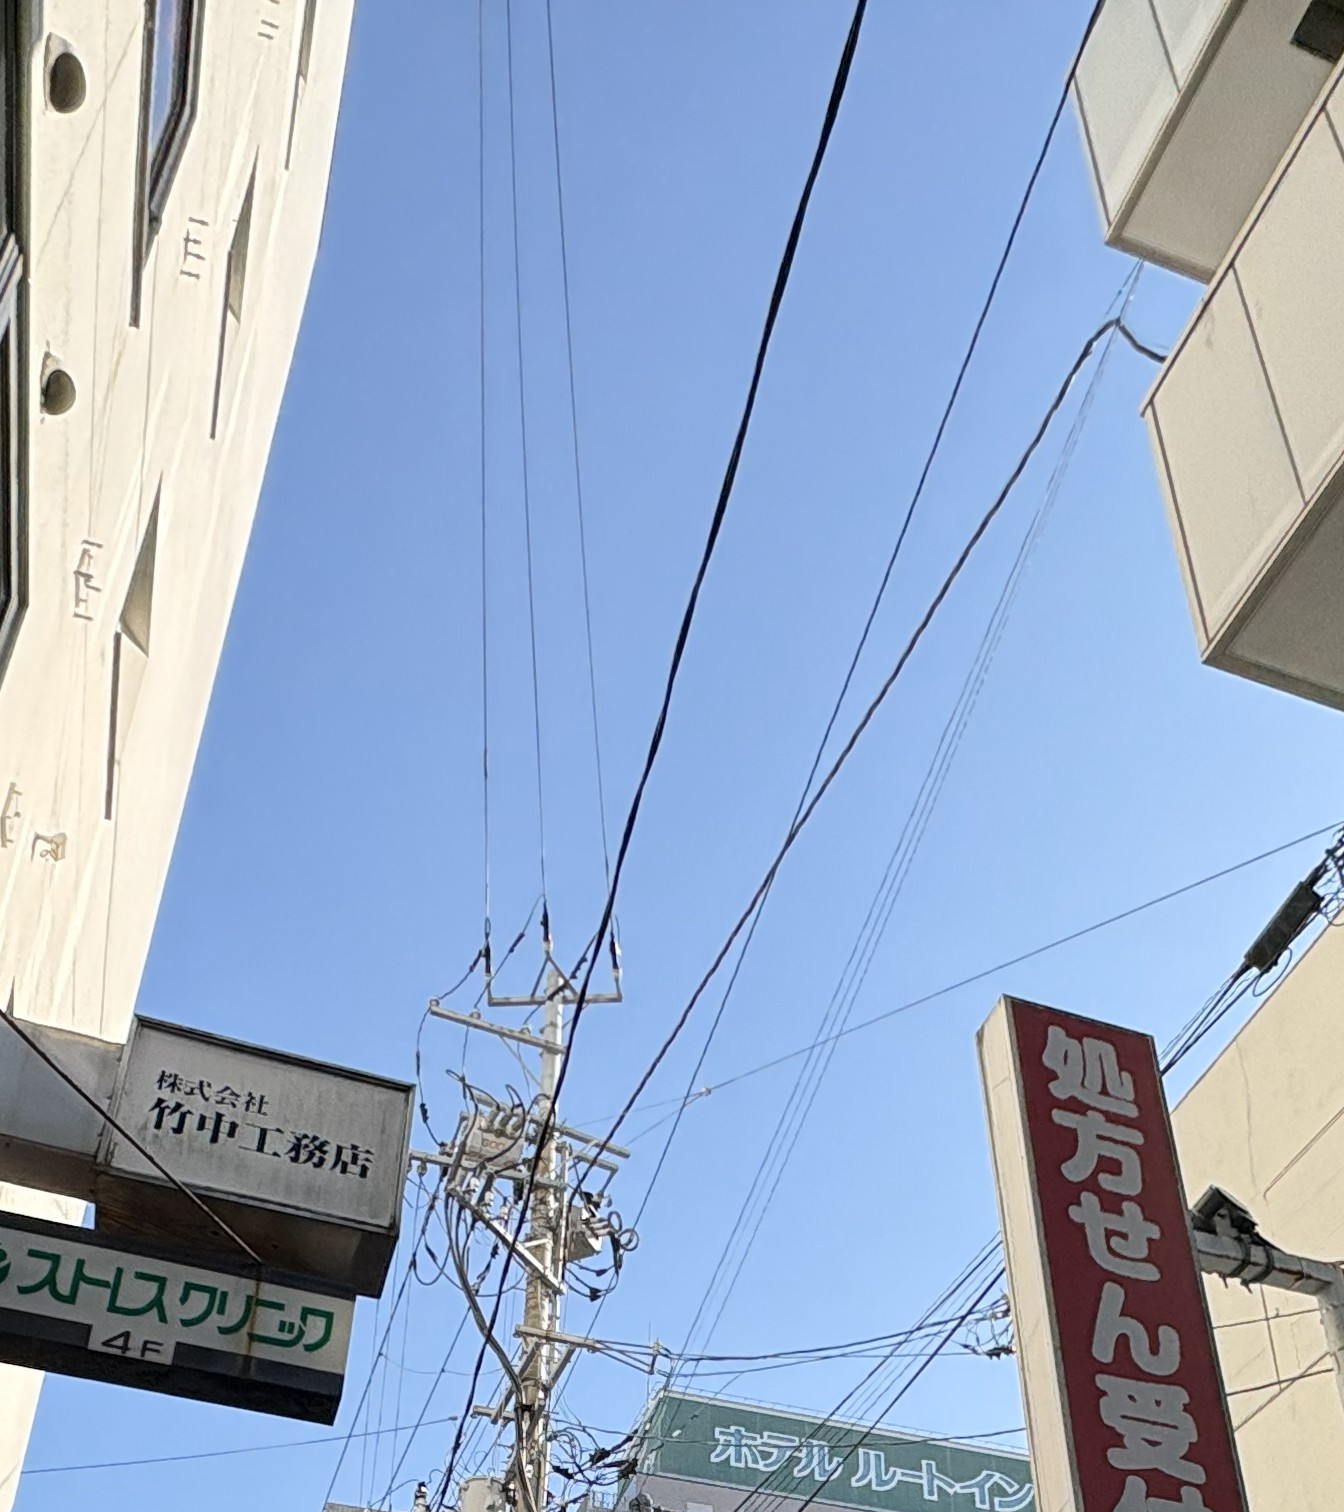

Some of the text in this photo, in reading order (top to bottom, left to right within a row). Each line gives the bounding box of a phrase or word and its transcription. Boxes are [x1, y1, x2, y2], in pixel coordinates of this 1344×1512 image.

[155, 1069, 269, 1117] 株式会社
[149, 1096, 374, 1179] 竹中工務店
[17, 1248, 334, 1352] ストレスクリニック
[101, 1331, 164, 1358] 4F
[711, 1426, 1034, 1512] ホテル ルートイン
